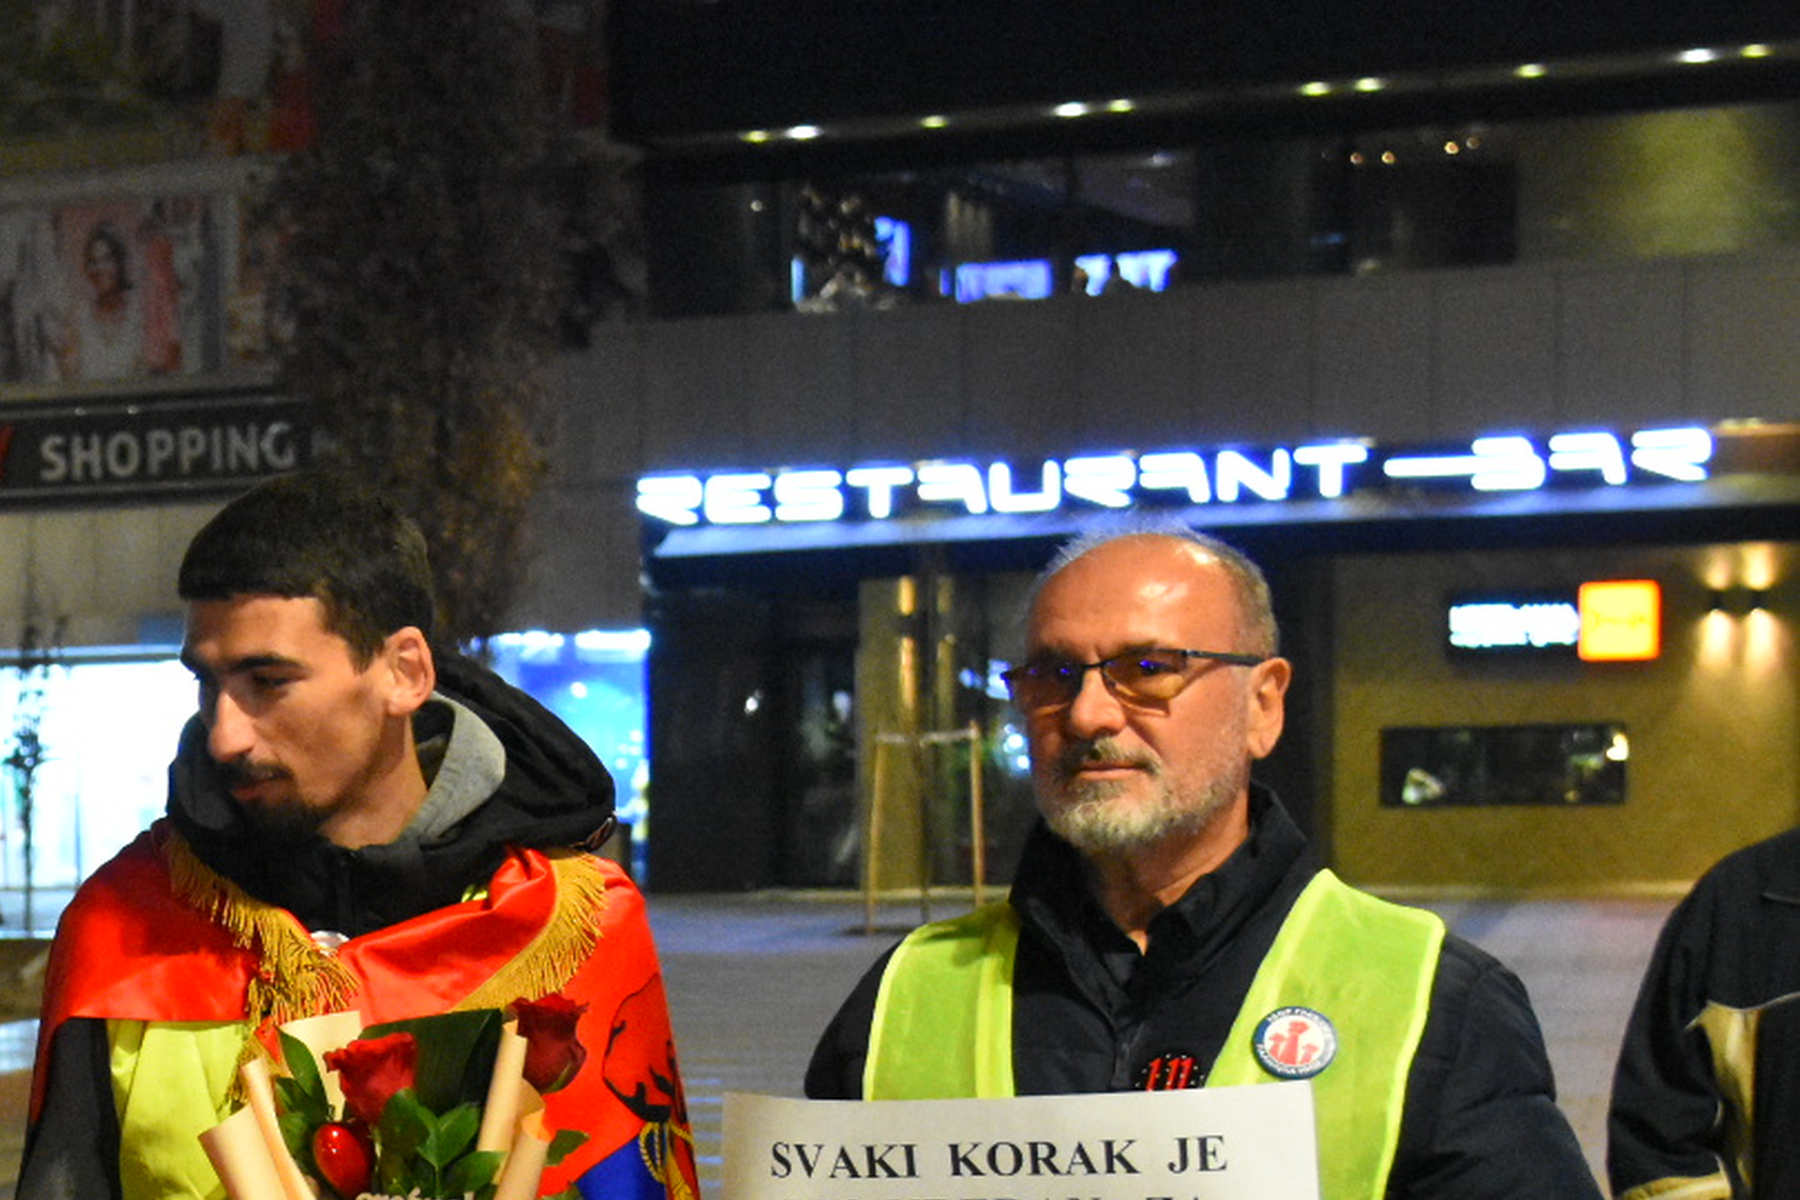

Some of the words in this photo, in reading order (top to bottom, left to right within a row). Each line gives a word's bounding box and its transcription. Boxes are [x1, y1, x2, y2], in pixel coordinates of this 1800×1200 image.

[39, 420, 296, 482] SHOPPING
[634, 440, 1368, 526] RESTAURANT
[770, 1141, 920, 1179] SVAKI
[948, 1139, 1141, 1177] KORAK
[1167, 1135, 1228, 1174] JE
